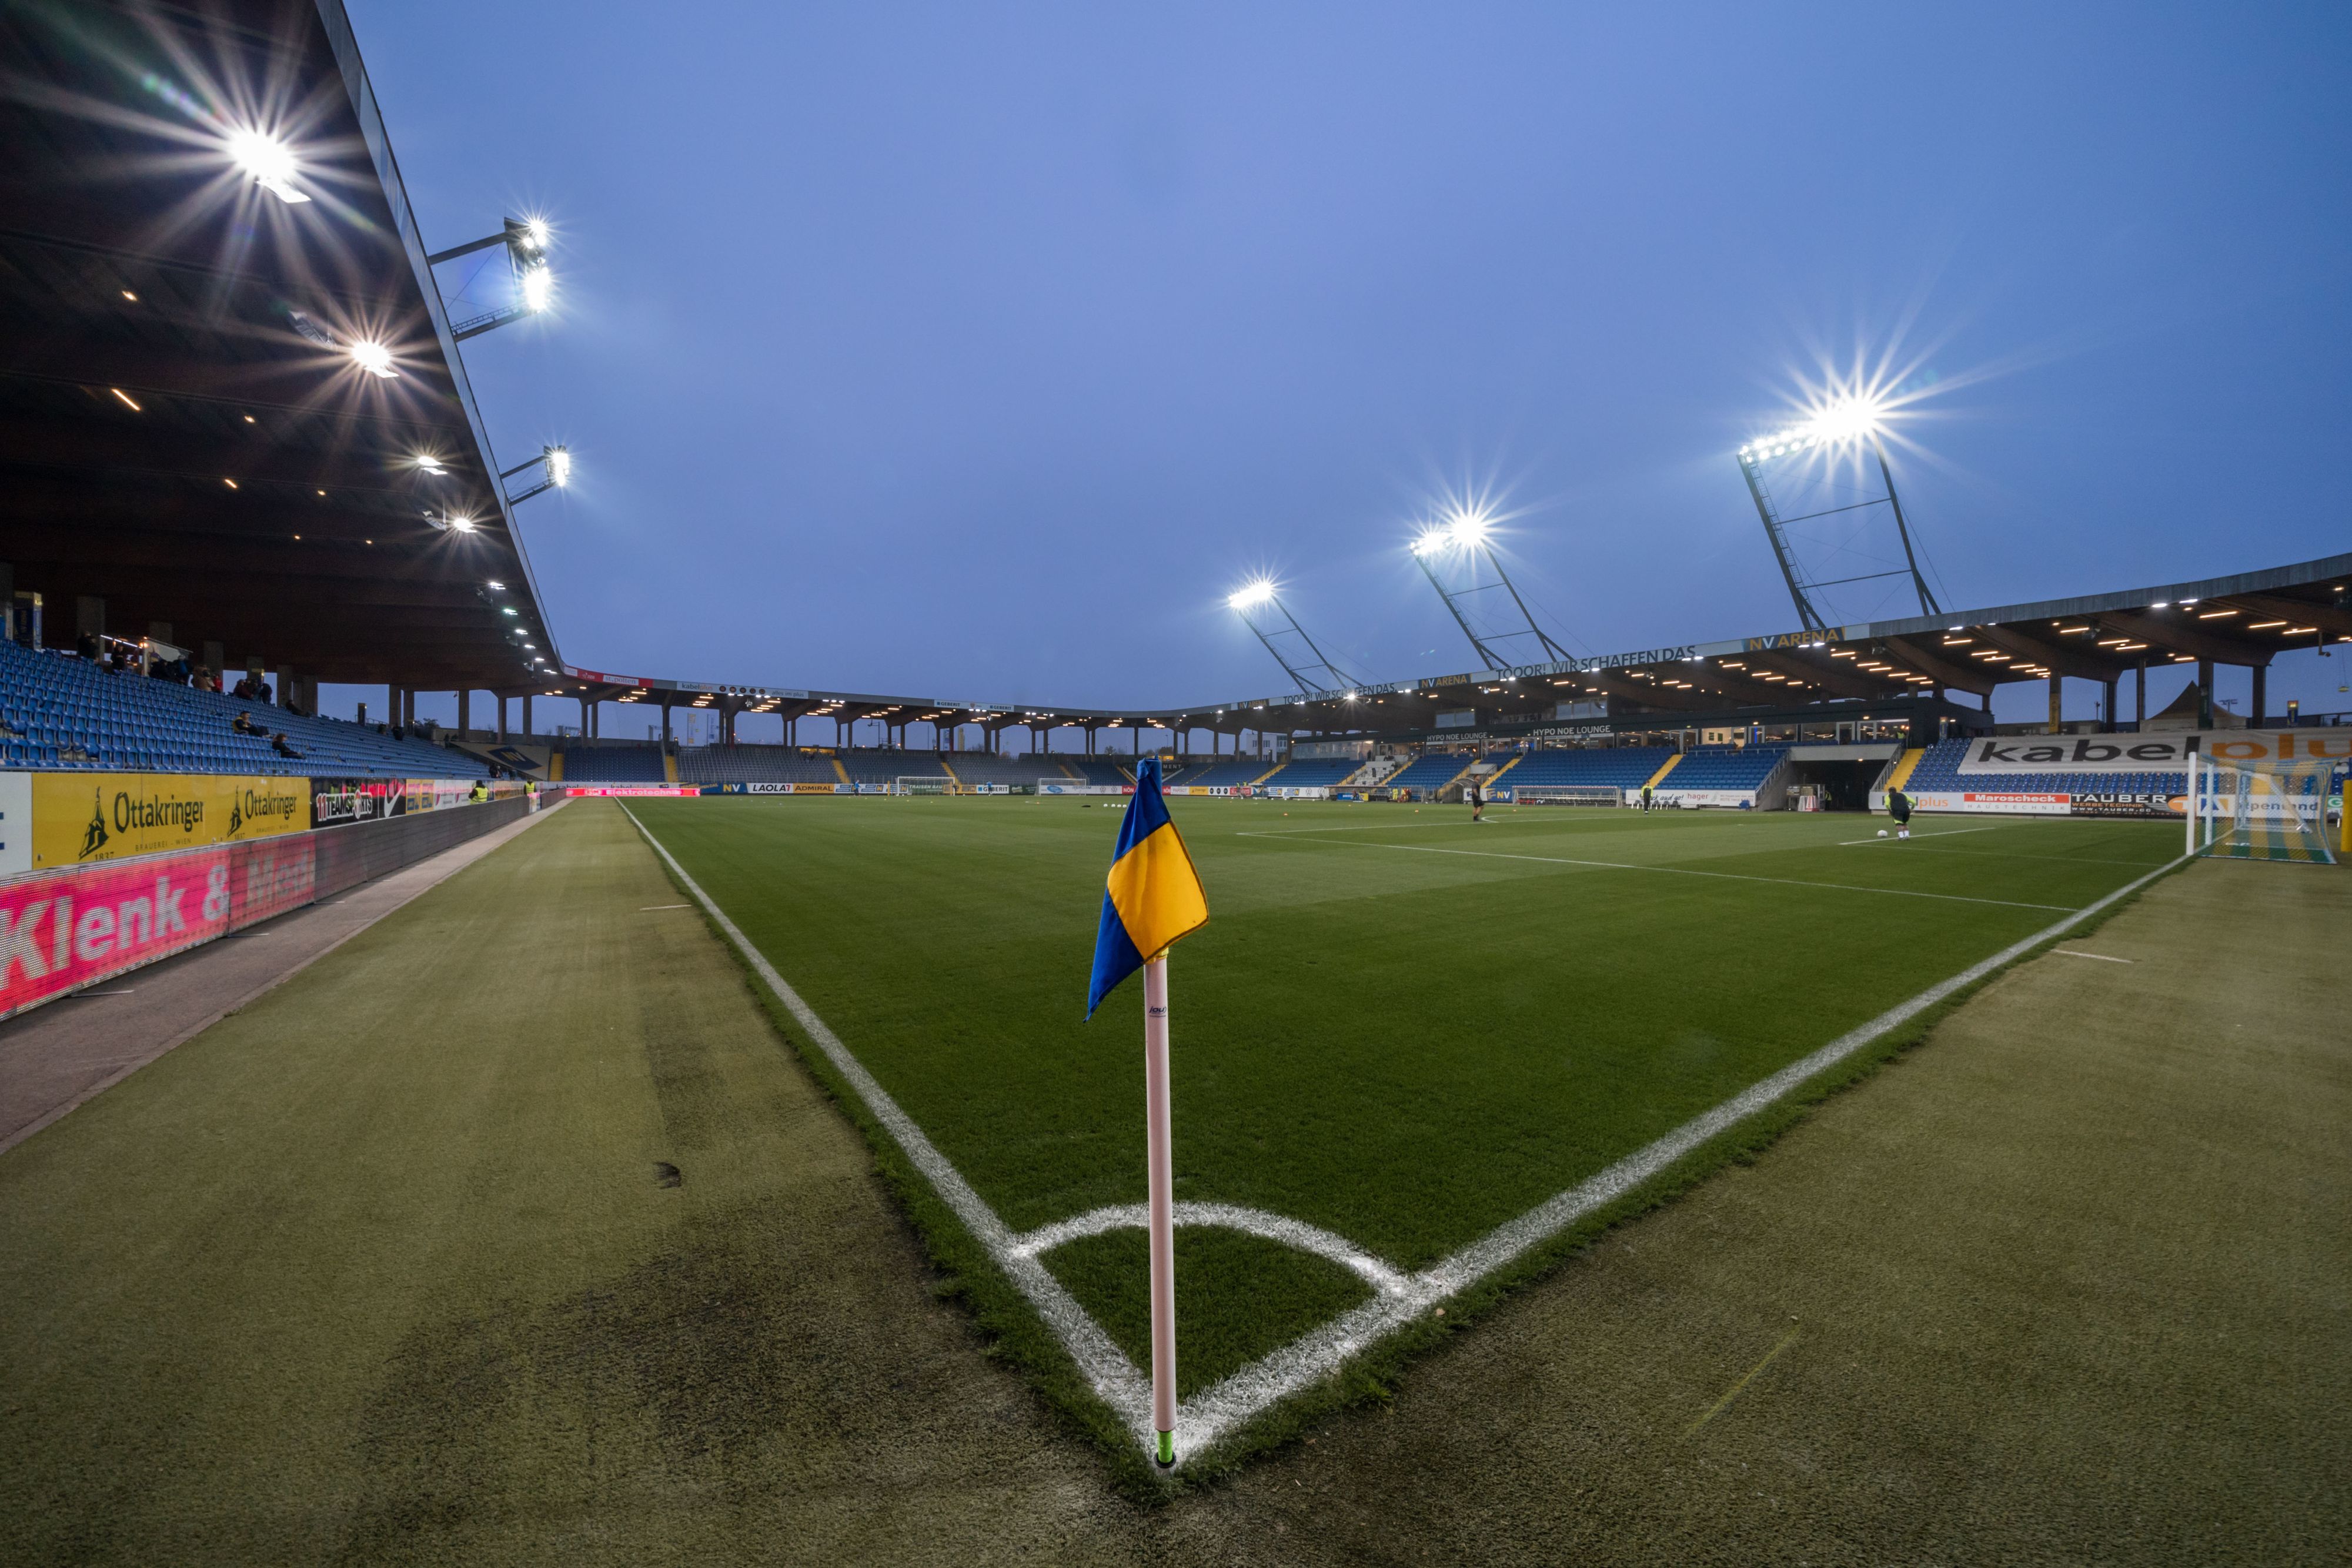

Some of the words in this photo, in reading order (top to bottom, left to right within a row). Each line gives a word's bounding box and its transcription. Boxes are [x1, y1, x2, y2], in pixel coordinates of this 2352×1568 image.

[1750, 636, 1775, 651] NV
[1777, 628, 1839, 647] ARENA
[1496, 664, 1546, 680] TOOOR!
[1551, 660, 1578, 674] WIR
[1581, 650, 1658, 671] SCHAFFEN
[681, 682, 713, 691] kabelplus
[1421, 678, 1435, 688] NV
[1436, 675, 1467, 686] ARENA
[1315, 690, 1329, 701] WIR
[1461, 731, 1488, 740] LOUNGE
[1532, 728, 1556, 736] HYPO
[1558, 727, 1575, 735] NOE
[1576, 725, 1611, 734] LOUNGE
[723, 784, 741, 792] NV
[1688, 793, 1709, 801] hager
[1975, 794, 2056, 803] Maroscheck
[2072, 794, 2167, 803] TAUBER
[245, 789, 297, 821] Ottakringer
[114, 791, 205, 834] Ottakringer
[135, 840, 168, 852] BRAUEREI
[176, 838, 192, 846] WIEN
[95, 851, 115, 861] 1837
[0, 876, 186, 992] Klenk
[202, 865, 229, 921] &
[247, 847, 315, 908] Med
